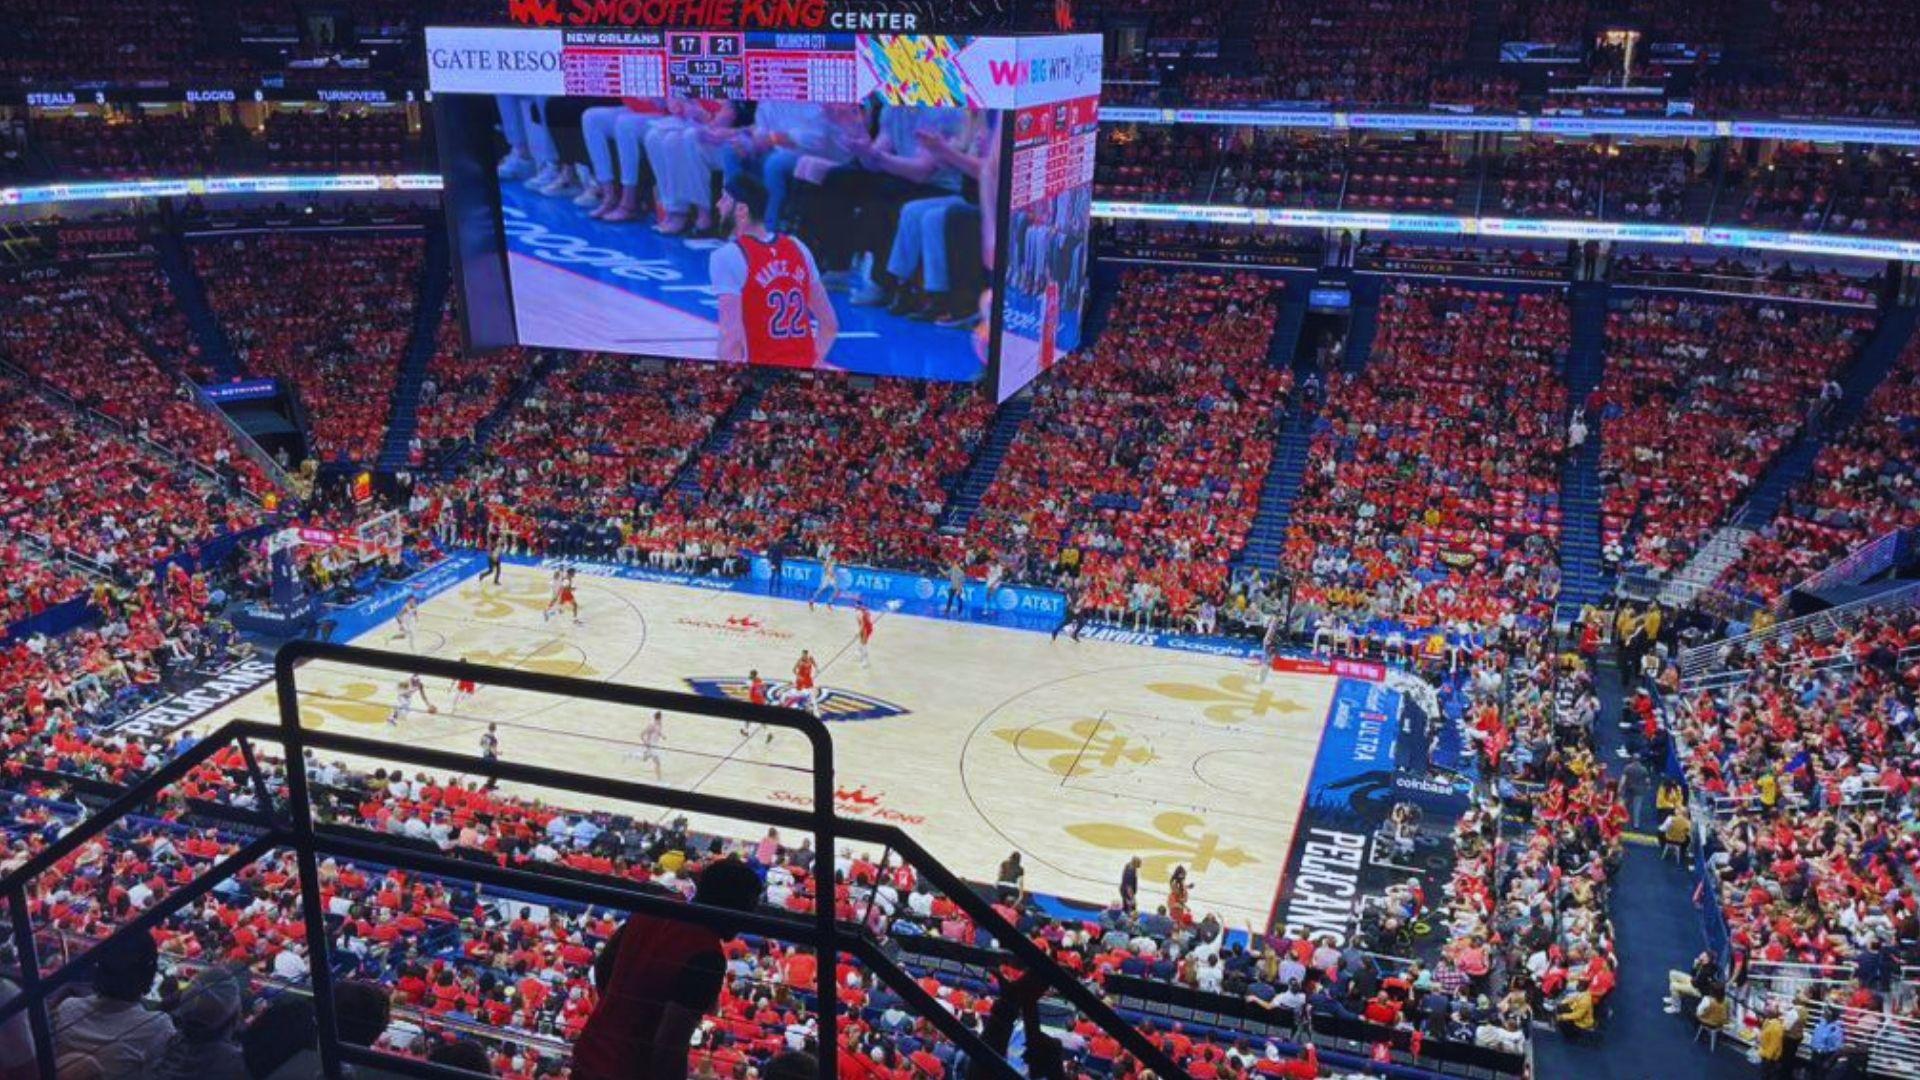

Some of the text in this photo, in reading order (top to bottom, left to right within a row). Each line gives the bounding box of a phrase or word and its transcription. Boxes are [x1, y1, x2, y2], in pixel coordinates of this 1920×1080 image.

[568, 0, 917, 30] SMOOTHIE KING CENTER
[566, 33, 660, 44] NEW ORLEANS
[679, 38, 695, 52] 17
[717, 39, 732, 52] 21
[428, 48, 491, 70] GATE
[1030, 58, 1047, 84] BIG
[27, 92, 76, 104] STEALS
[186, 90, 236, 101] BLOCKS
[317, 90, 387, 101] TURNOVERS
[767, 286, 808, 339] 22
[855, 573, 893, 591] AT&T
[1020, 593, 1064, 612] AT&T
[1167, 637, 1244, 656] Google
[115, 661, 275, 735] PELICANS
[1395, 776, 1453, 795] coinbase
[1285, 827, 1366, 948] PELICANS
